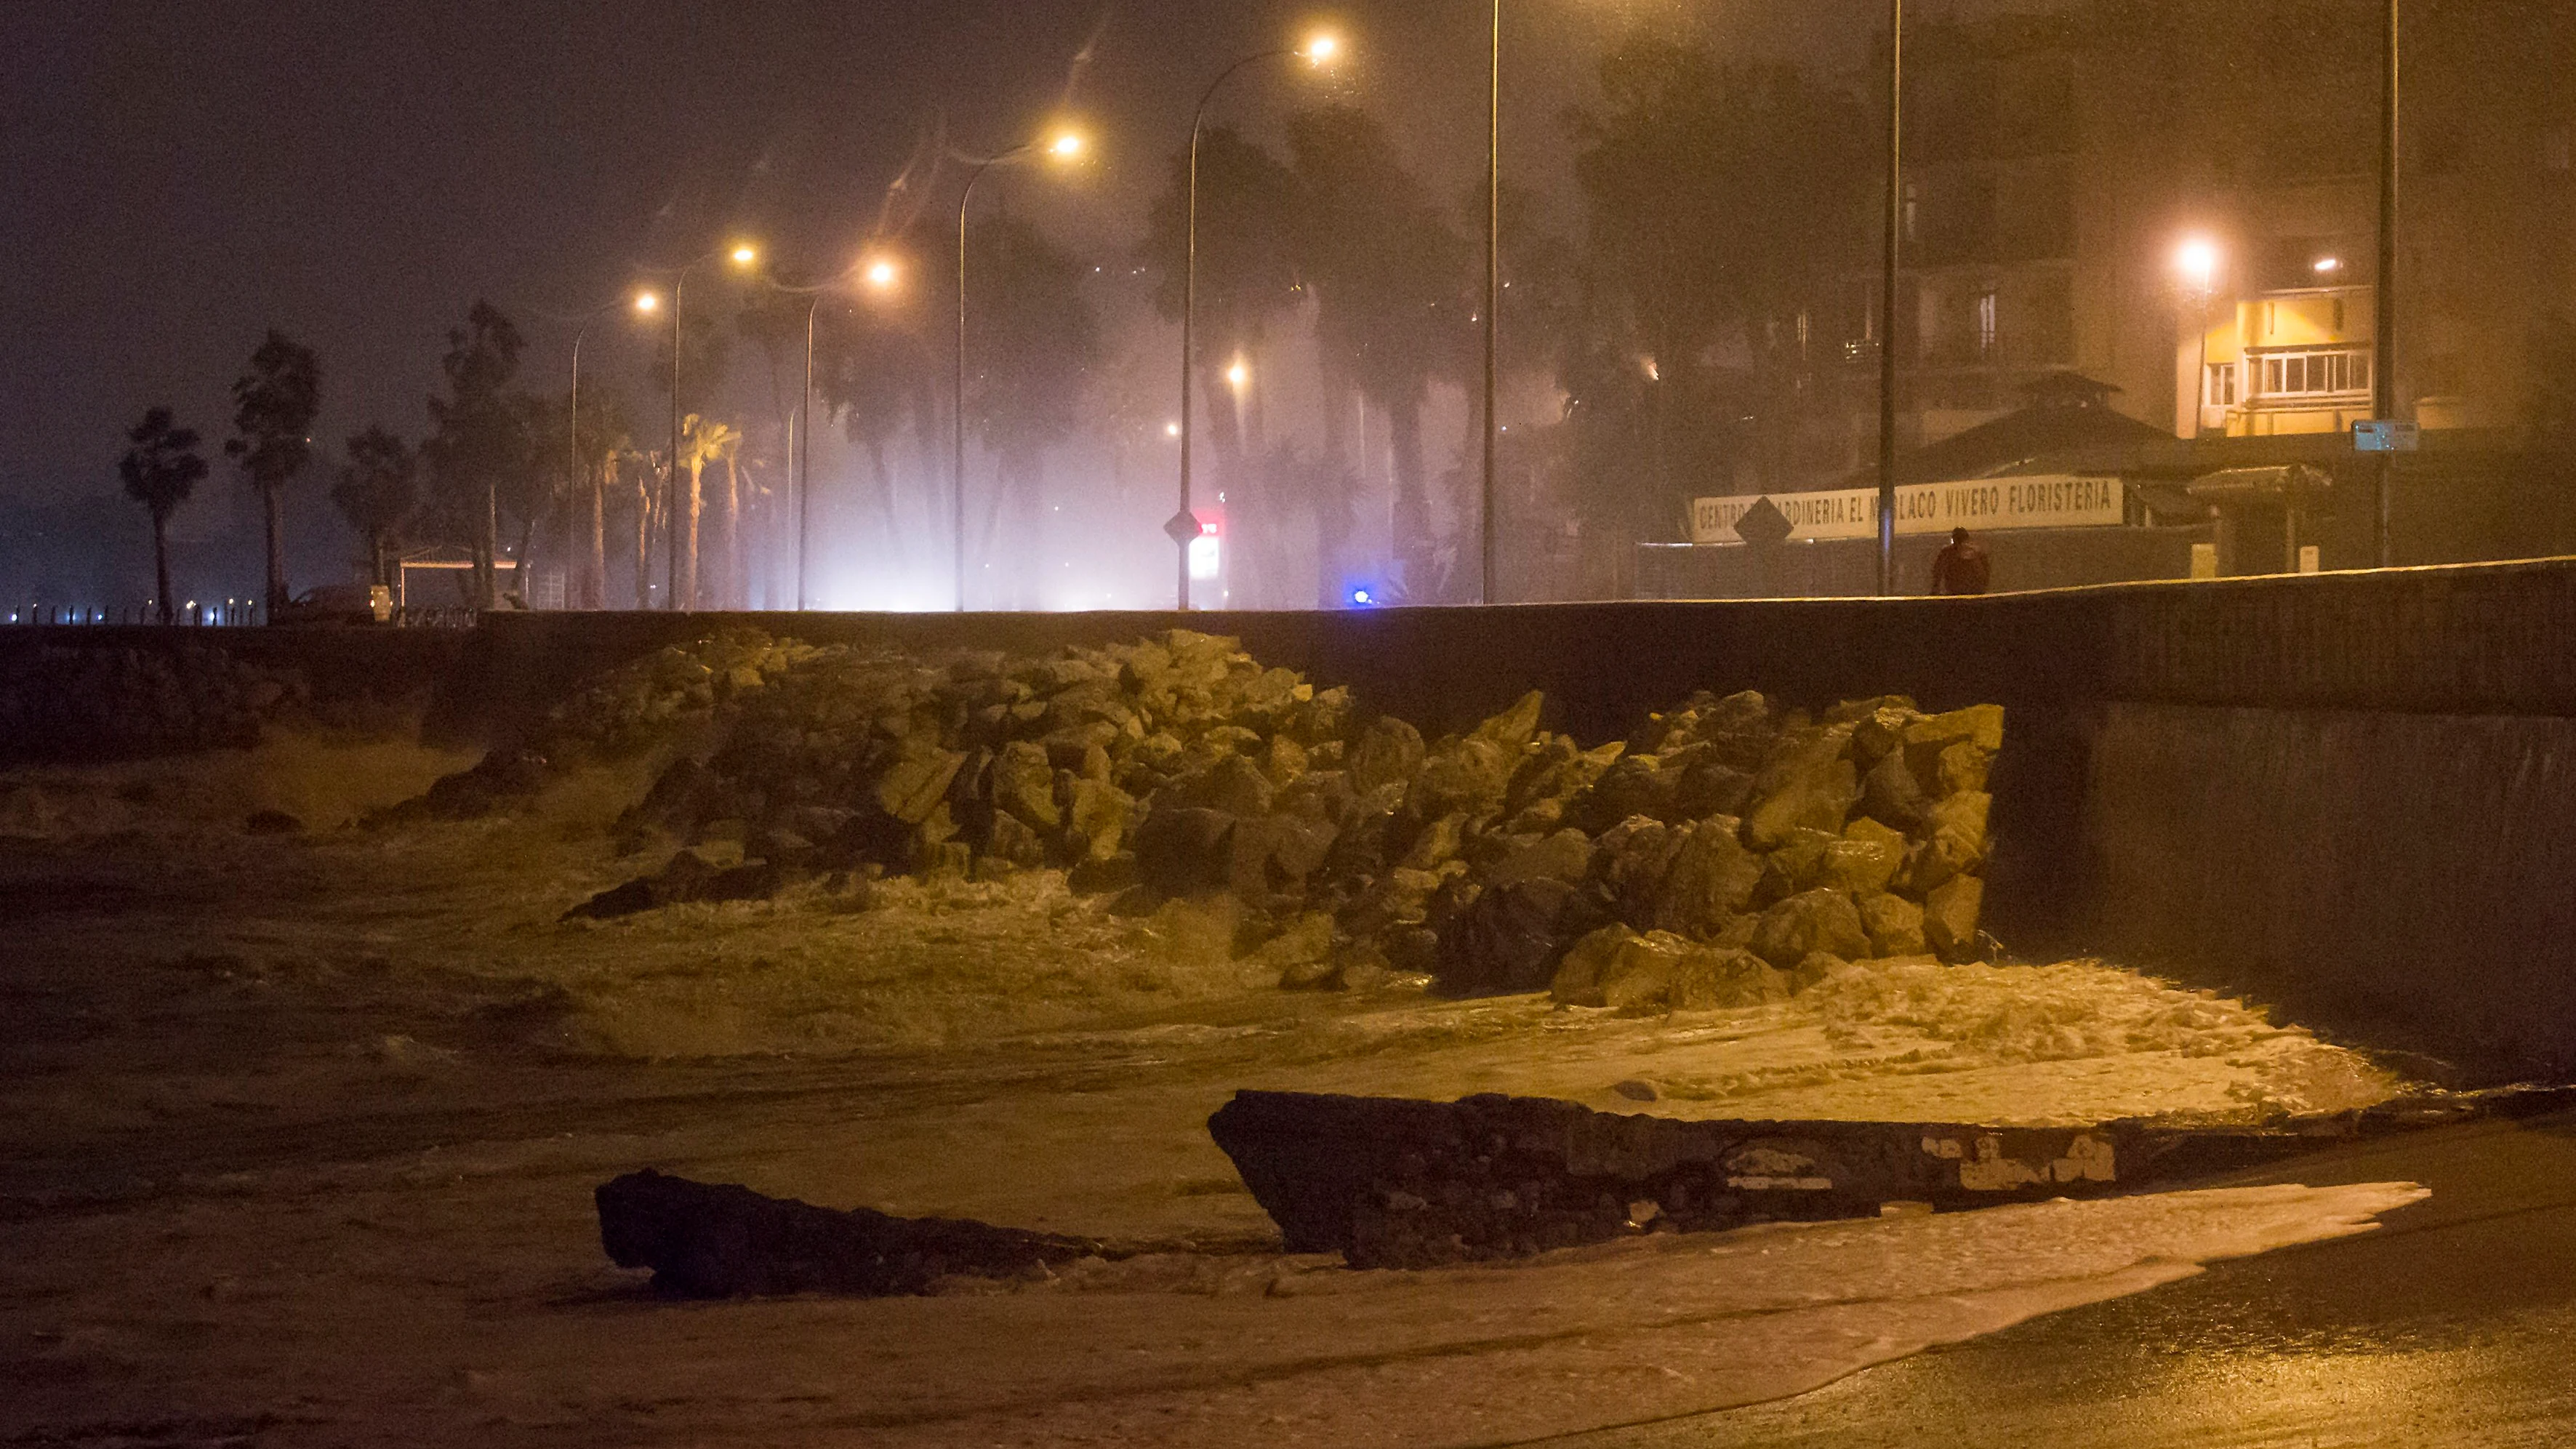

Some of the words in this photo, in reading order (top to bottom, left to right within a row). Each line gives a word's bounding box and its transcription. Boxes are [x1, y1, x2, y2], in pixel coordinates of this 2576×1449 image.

[1699, 502, 1746, 529] CENTRO
[1776, 497, 1845, 526] RDINERIA
[1850, 496, 1863, 523] EL
[1869, 490, 1936, 522] MLACO
[1946, 486, 1999, 516] VIVERO
[2009, 480, 2111, 513] FLORISTERIA
